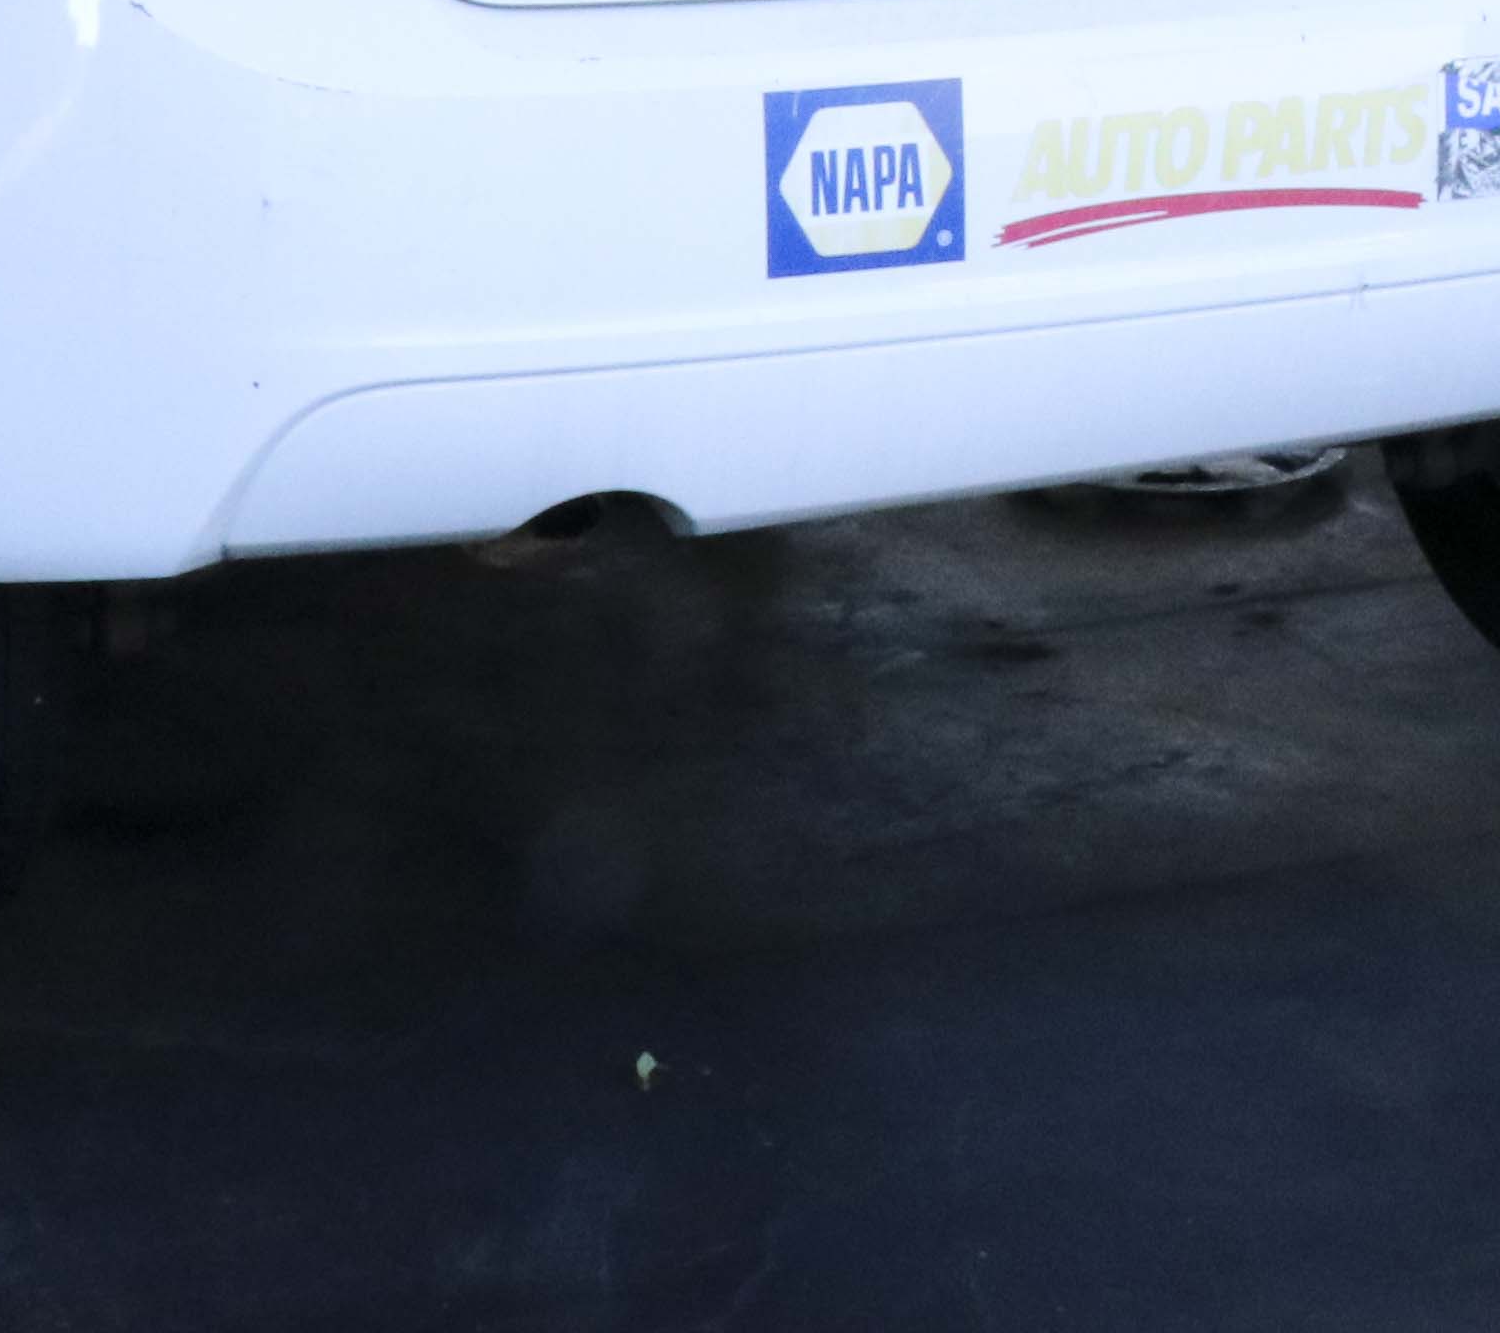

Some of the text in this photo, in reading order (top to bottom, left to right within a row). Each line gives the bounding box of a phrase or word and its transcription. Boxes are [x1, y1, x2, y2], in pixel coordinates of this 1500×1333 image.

[810, 142, 926, 217] NAPA
[1013, 81, 1430, 201] AUTO PARTS
